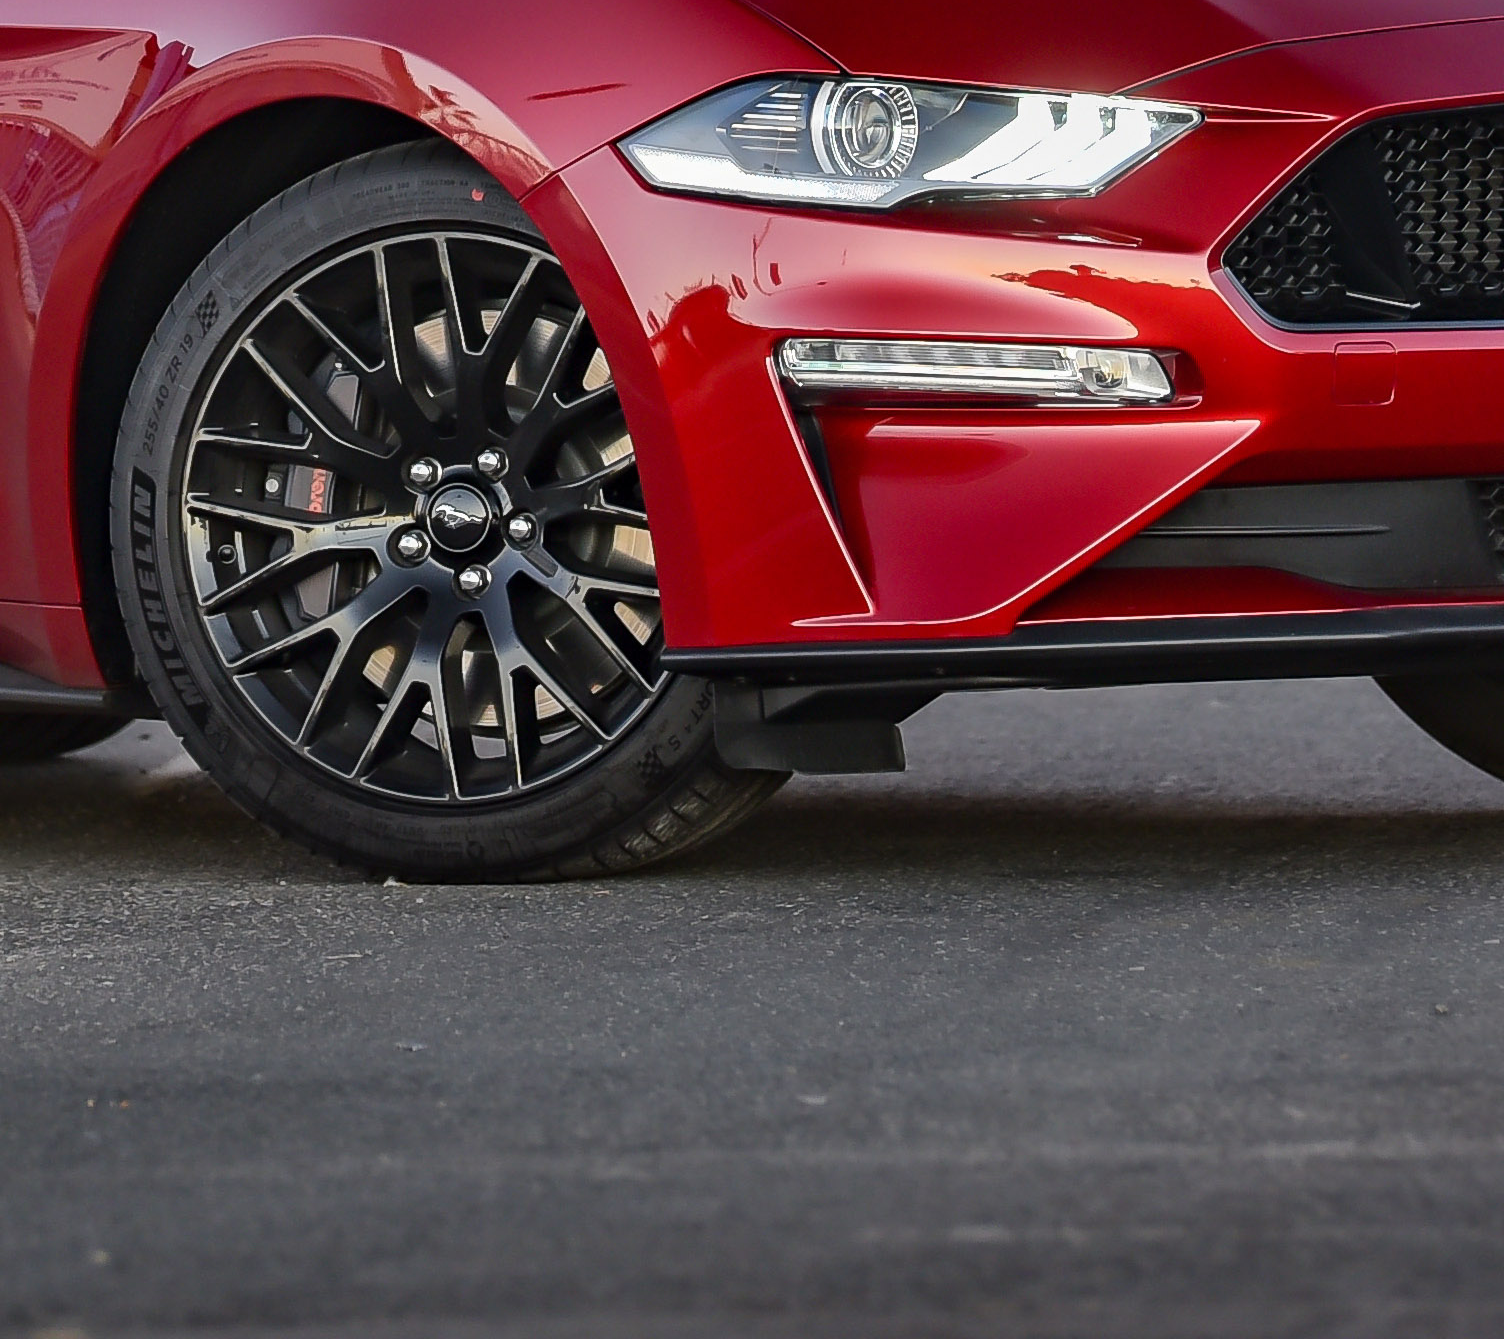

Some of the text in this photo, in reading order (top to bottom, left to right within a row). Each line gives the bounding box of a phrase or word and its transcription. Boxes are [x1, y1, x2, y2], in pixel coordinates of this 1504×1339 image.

[142, 333, 194, 457] 255/40 ZR 19
[133, 485, 204, 706] MICHELIN
